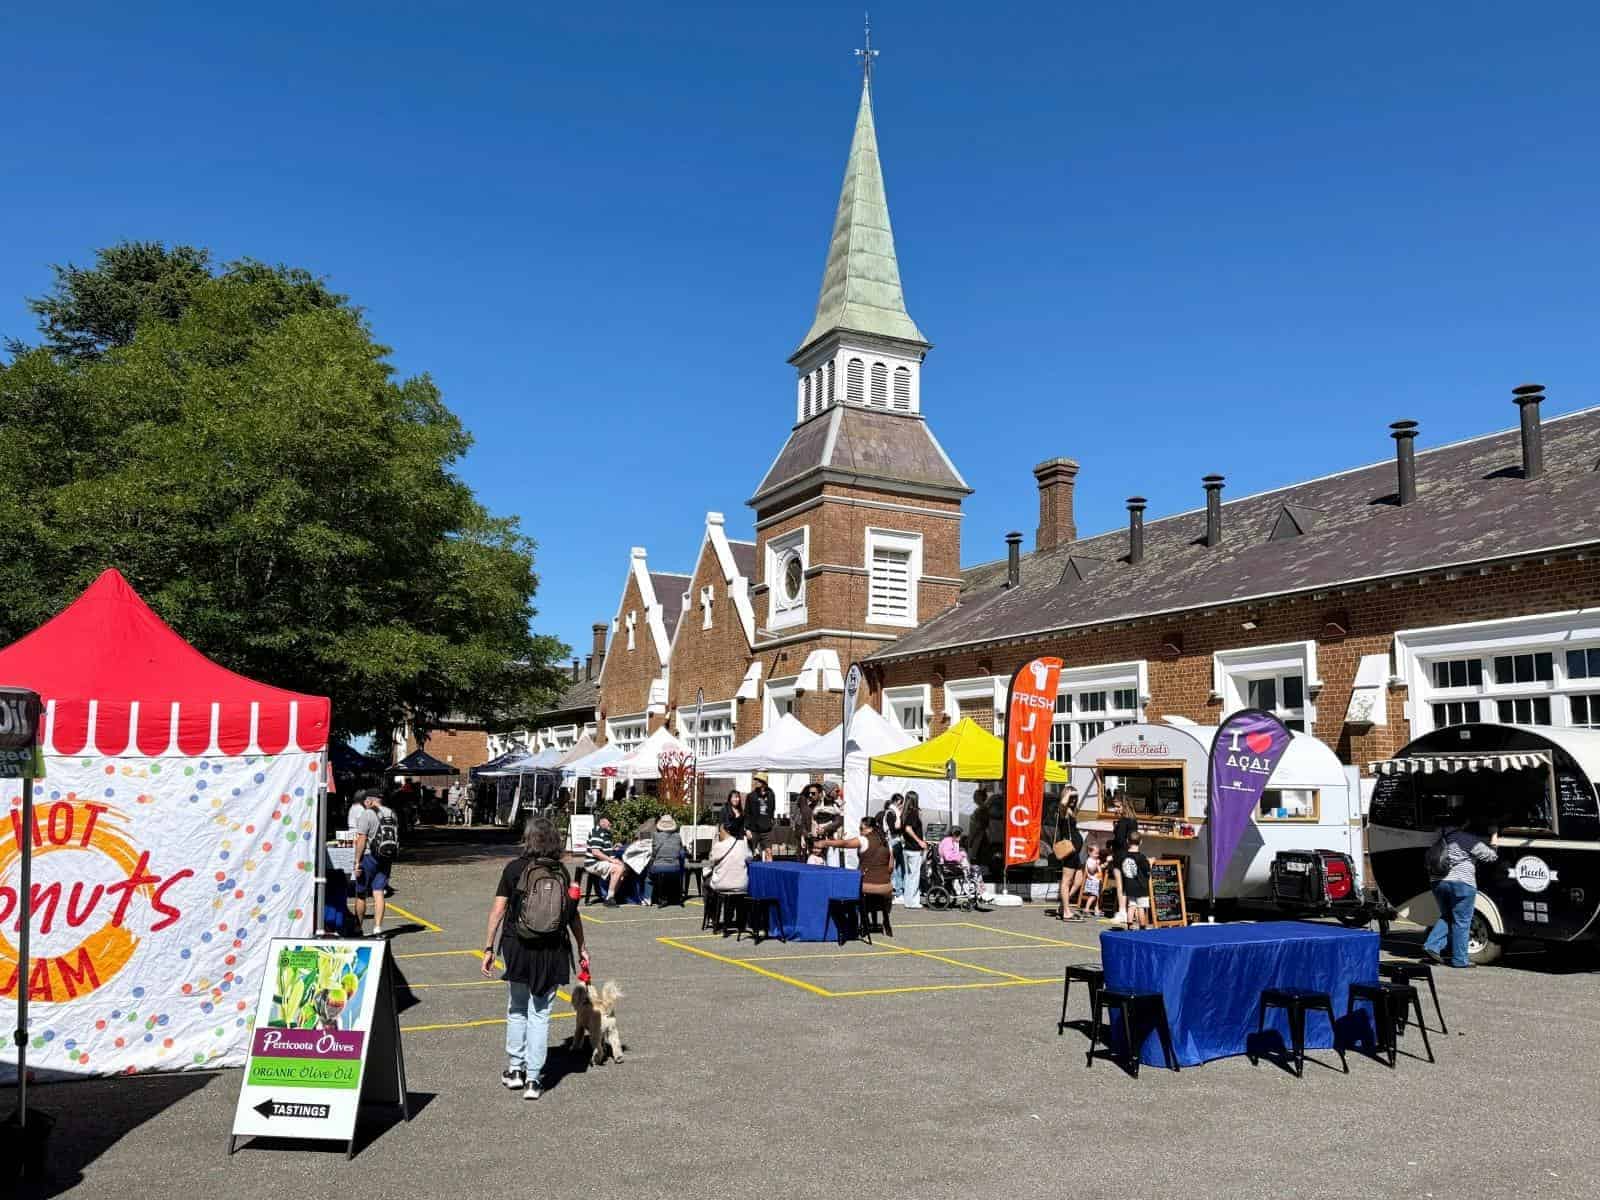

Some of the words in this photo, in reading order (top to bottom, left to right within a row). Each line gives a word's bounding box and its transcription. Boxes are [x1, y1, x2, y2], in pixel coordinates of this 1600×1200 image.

[1012, 691, 1055, 711] FRESH
[1228, 729, 1243, 752] I
[1225, 754, 1272, 772] AÇAI
[1008, 711, 1037, 859] JUICE
[10, 801, 109, 853] HOT
[263, 1030, 314, 1052] Perricoota
[315, 1030, 355, 1054] Olives
[252, 1066, 296, 1078] ORGANIC
[300, 1065, 331, 1079] Olive
[334, 1066, 353, 1080] Oil
[272, 1103, 328, 1117] TASTINGS
